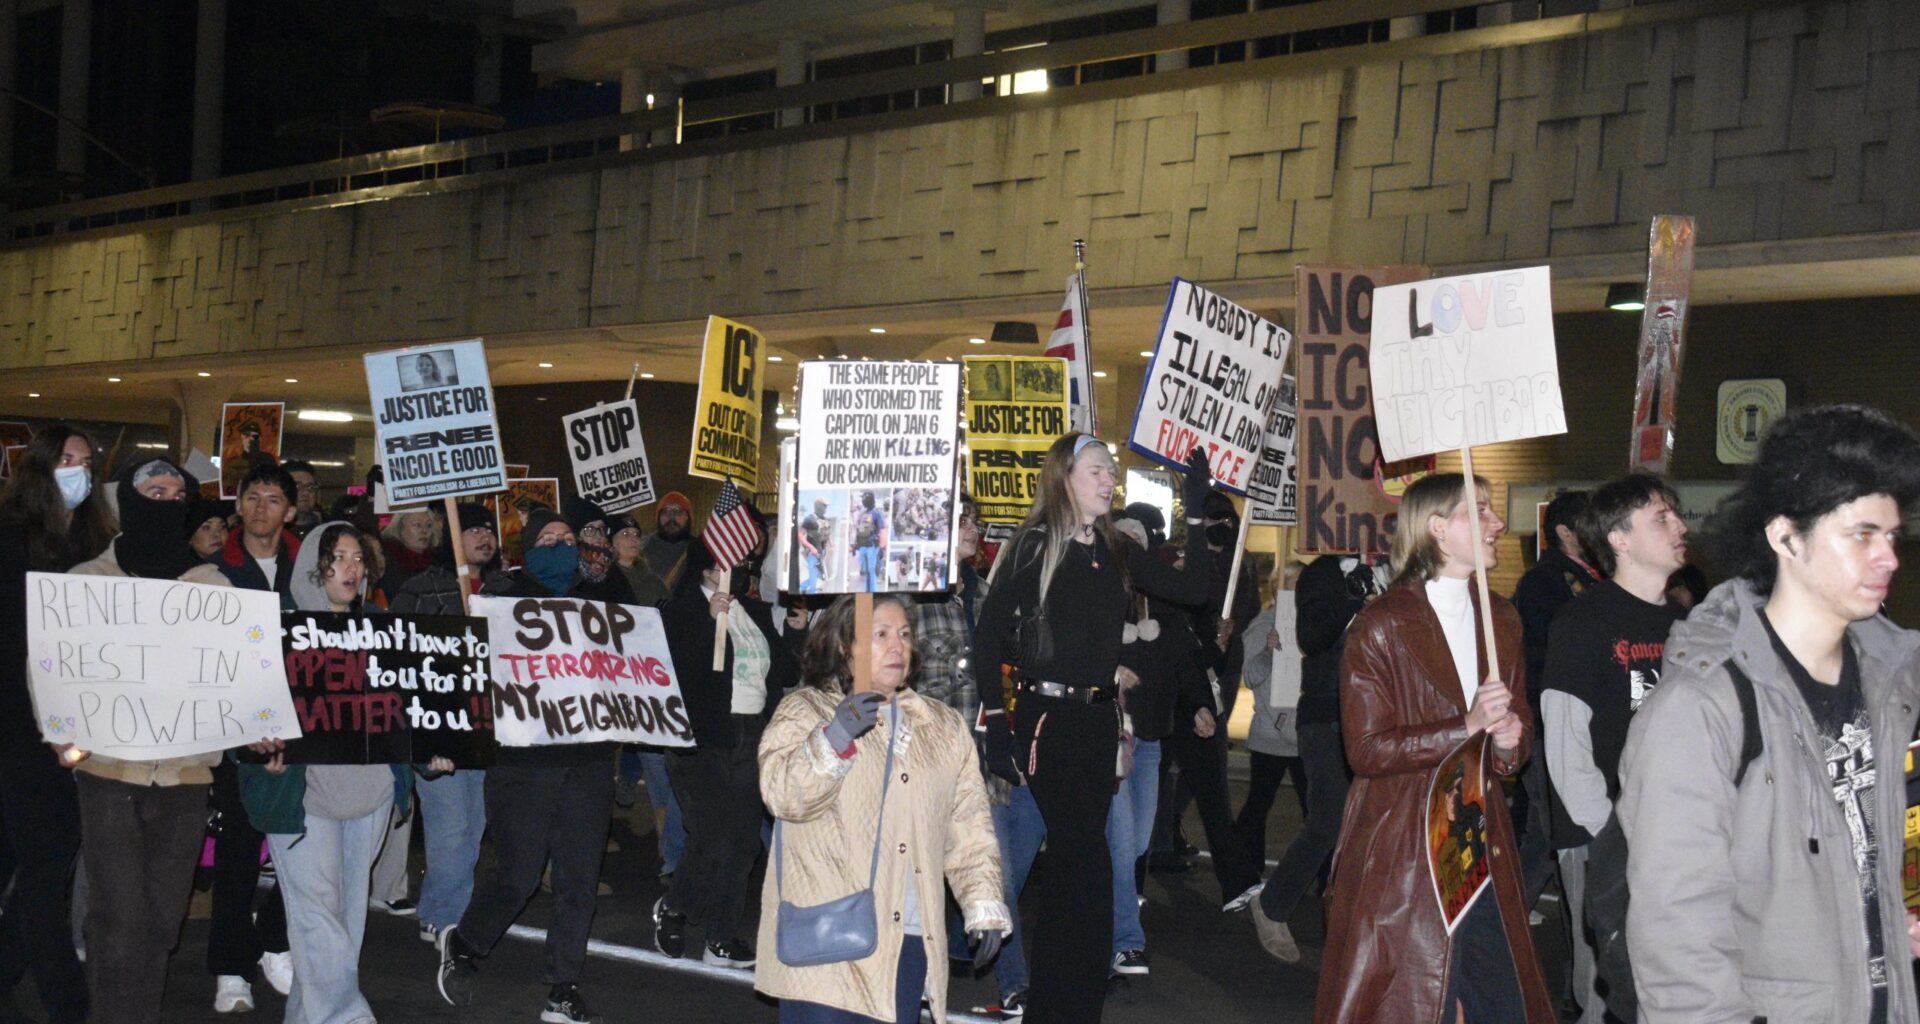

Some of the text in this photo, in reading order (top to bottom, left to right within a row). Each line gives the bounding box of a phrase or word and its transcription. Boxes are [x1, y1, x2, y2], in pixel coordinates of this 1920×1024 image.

[1186, 283, 1286, 360] NOBODY IS
[1308, 272, 1375, 334] NO
[1409, 272, 1525, 340] LOVE
[828, 364, 940, 385] THE SAME PEOPLE
[1168, 331, 1278, 416] ILLEGAL ON
[1304, 342, 1369, 410] IC
[1382, 332, 1471, 394] THY
[380, 386, 488, 424] JUSTICE FOR
[708, 402, 731, 430] OUT
[731, 408, 746, 434] OF
[822, 389, 942, 410] WHO STORMED THE
[969, 405, 1031, 434] JUSTICE
[1033, 406, 1064, 435] FOR
[1158, 373, 1260, 453] STOLEN LAND
[1376, 372, 1563, 458] NEIGHBOR
[386, 425, 494, 454] RENEE
[570, 406, 634, 461] STOP
[825, 414, 938, 434] CAPITOL ON JAN 6
[1156, 419, 1200, 462] FUCK
[1273, 414, 1296, 439] FOR
[388, 445, 498, 482] NICOLE GOOD
[825, 439, 850, 459] ARE
[852, 439, 881, 459] NOW
[972, 449, 1046, 468] RENE
[1308, 415, 1378, 480] NO
[395, 476, 500, 498] PARTY FOR SOCIALISM & LIBERATION
[580, 457, 646, 492] ICE TERROR
[584, 477, 648, 504] NOW!
[817, 464, 938, 484] OUR COMMUNITIES
[974, 472, 1024, 498] NICOLE
[38, 578, 242, 630] RENEE GOOD
[291, 617, 489, 658] shouldn't have to
[513, 598, 636, 655] STOP
[58, 641, 240, 684] REST IN
[286, 647, 367, 691] PPEN
[420, 656, 458, 693] for
[462, 660, 488, 692] it
[80, 691, 244, 744] POWER
[406, 696, 441, 730] to
[492, 680, 694, 741] MY NEIGHBORS
